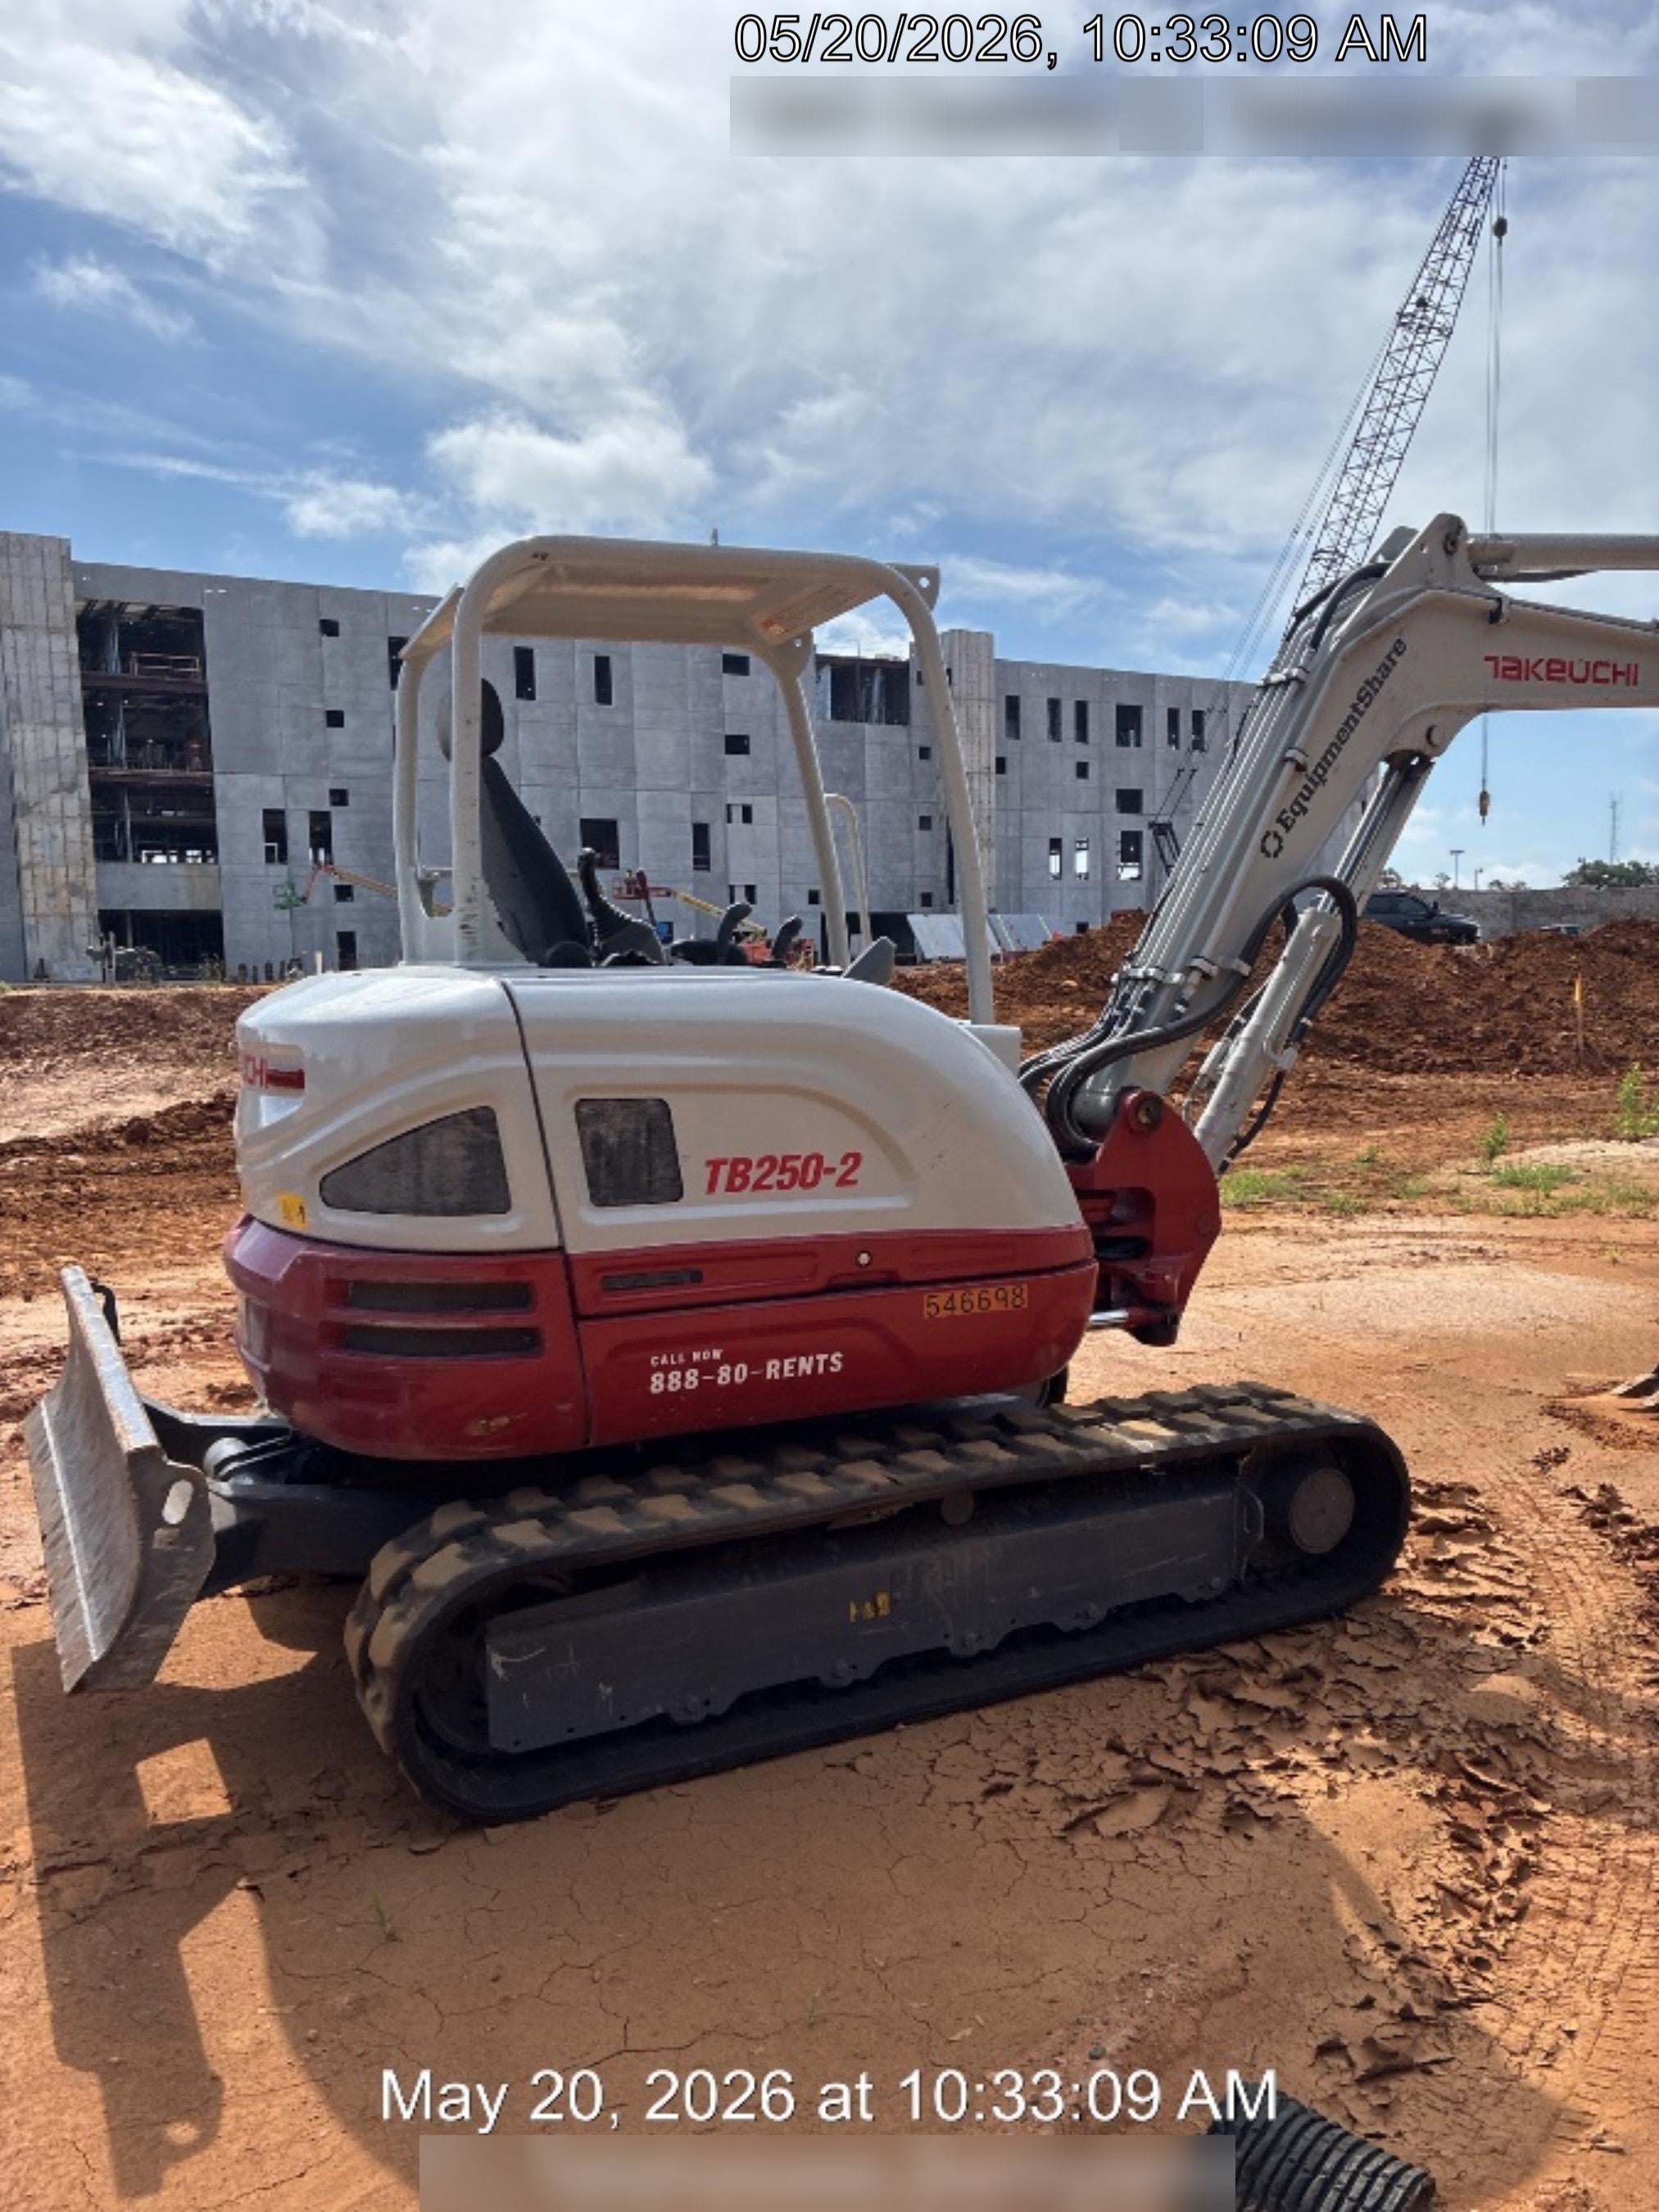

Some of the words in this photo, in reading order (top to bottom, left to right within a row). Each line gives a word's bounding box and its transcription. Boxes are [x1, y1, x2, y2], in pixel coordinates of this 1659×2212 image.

[1276, 638, 1407, 834] EquipmentShare
[705, 1152, 863, 1194] TB250-2
[925, 1285, 1025, 1317] 546698
[650, 1353, 686, 1367] CALL
[692, 1349, 723, 1362] NOW
[650, 1352, 844, 1394] 888-80-RENTS
